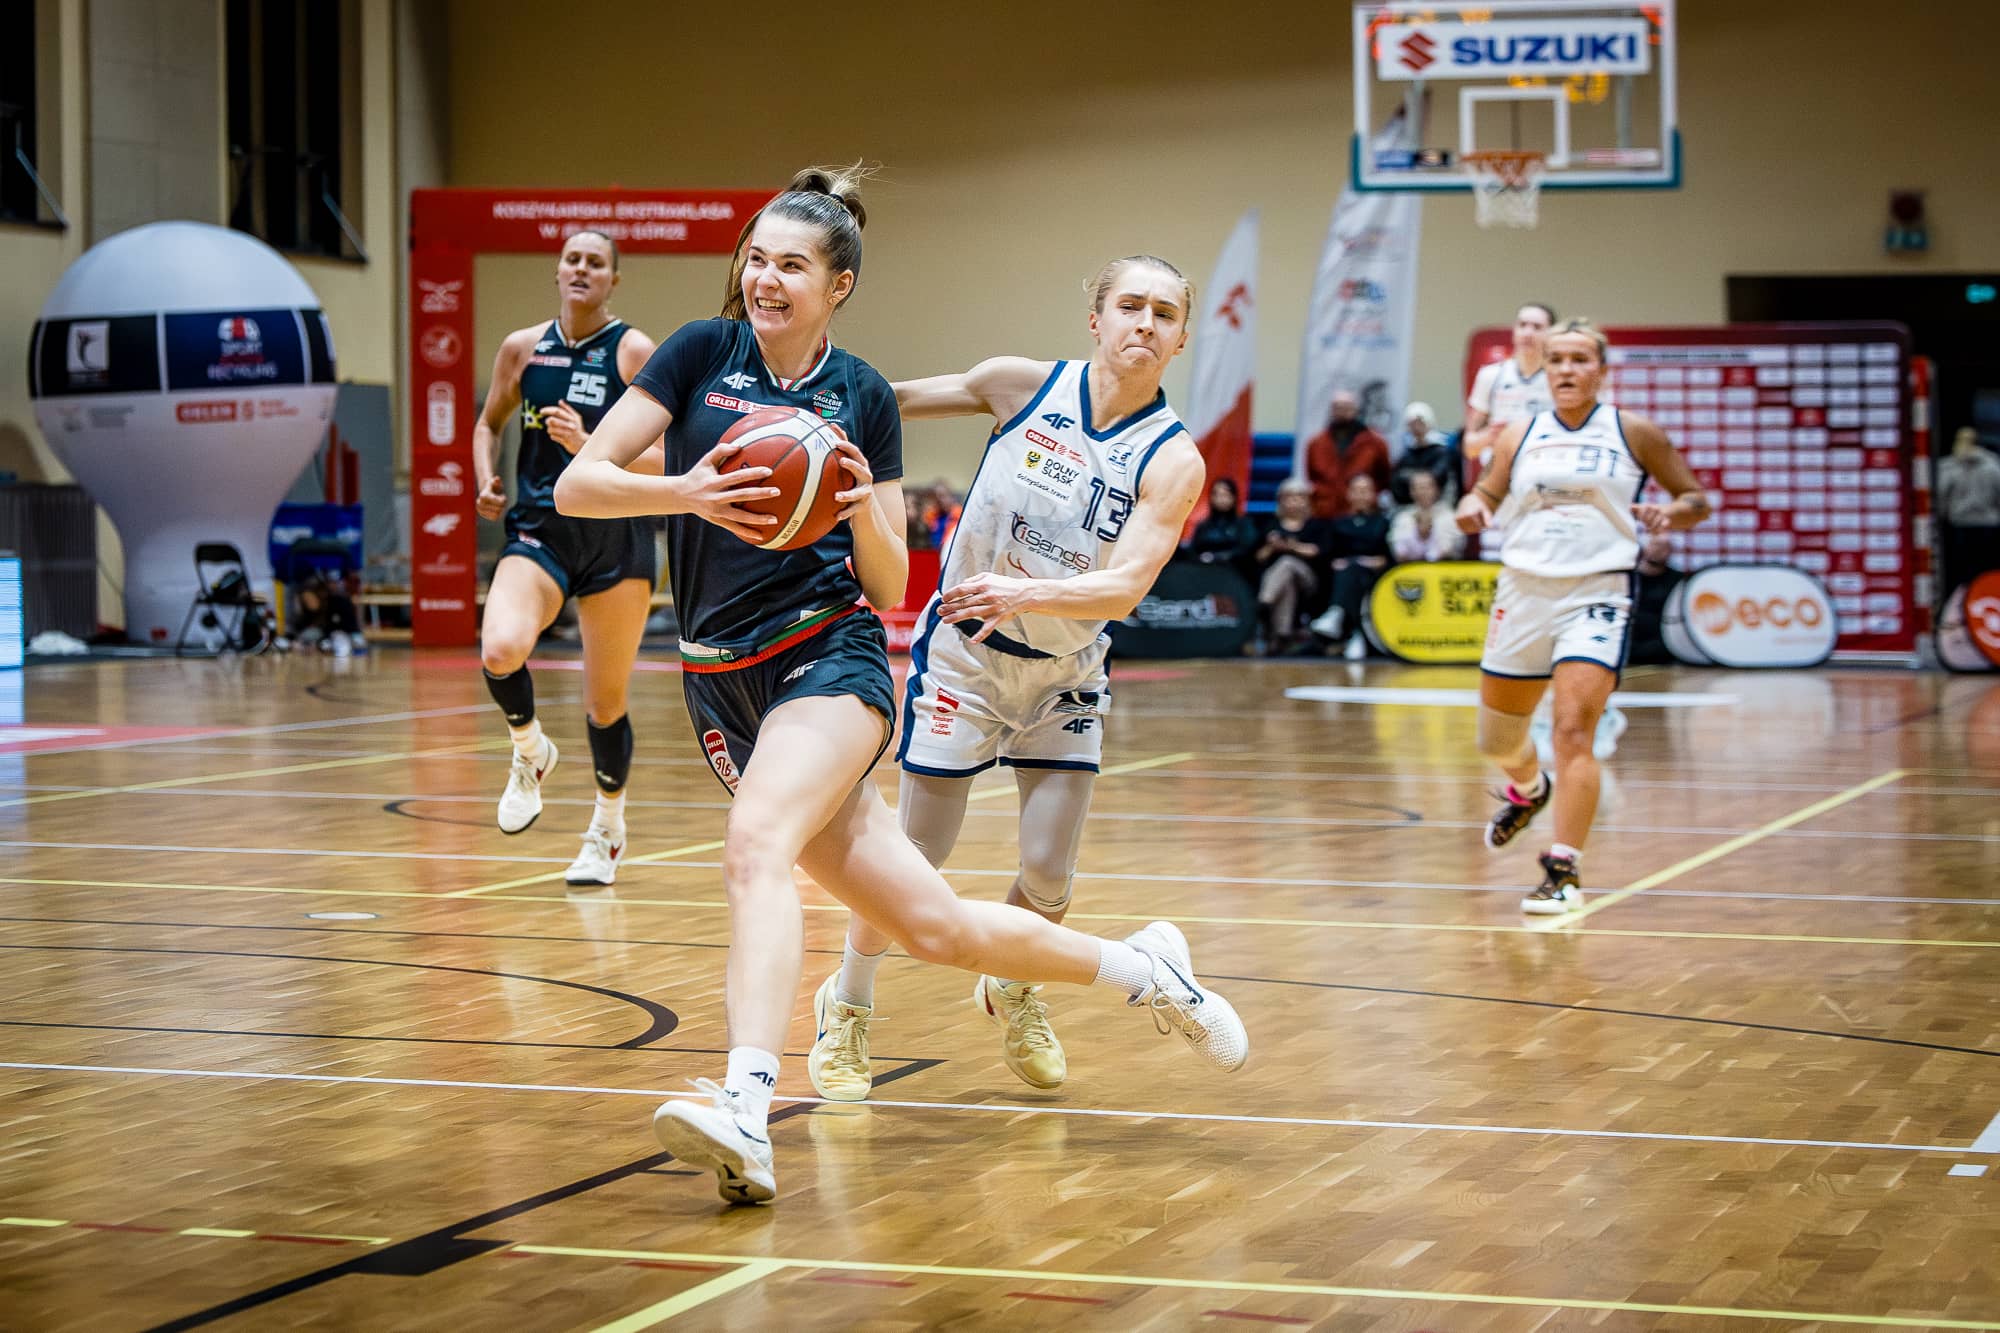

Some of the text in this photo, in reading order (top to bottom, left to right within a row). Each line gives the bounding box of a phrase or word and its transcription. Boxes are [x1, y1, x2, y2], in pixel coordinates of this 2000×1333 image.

[1453, 33, 1638, 64] SUZUKI
[566, 371, 607, 406] 25
[722, 372, 758, 390] 4F
[708, 395, 738, 408] ORLEN
[1041, 413, 1076, 431] 4F
[1045, 458, 1080, 479] DOLNY
[1081, 477, 1134, 543] 13
[1736, 597, 1822, 629] eco
[1062, 718, 1094, 734] 4F
